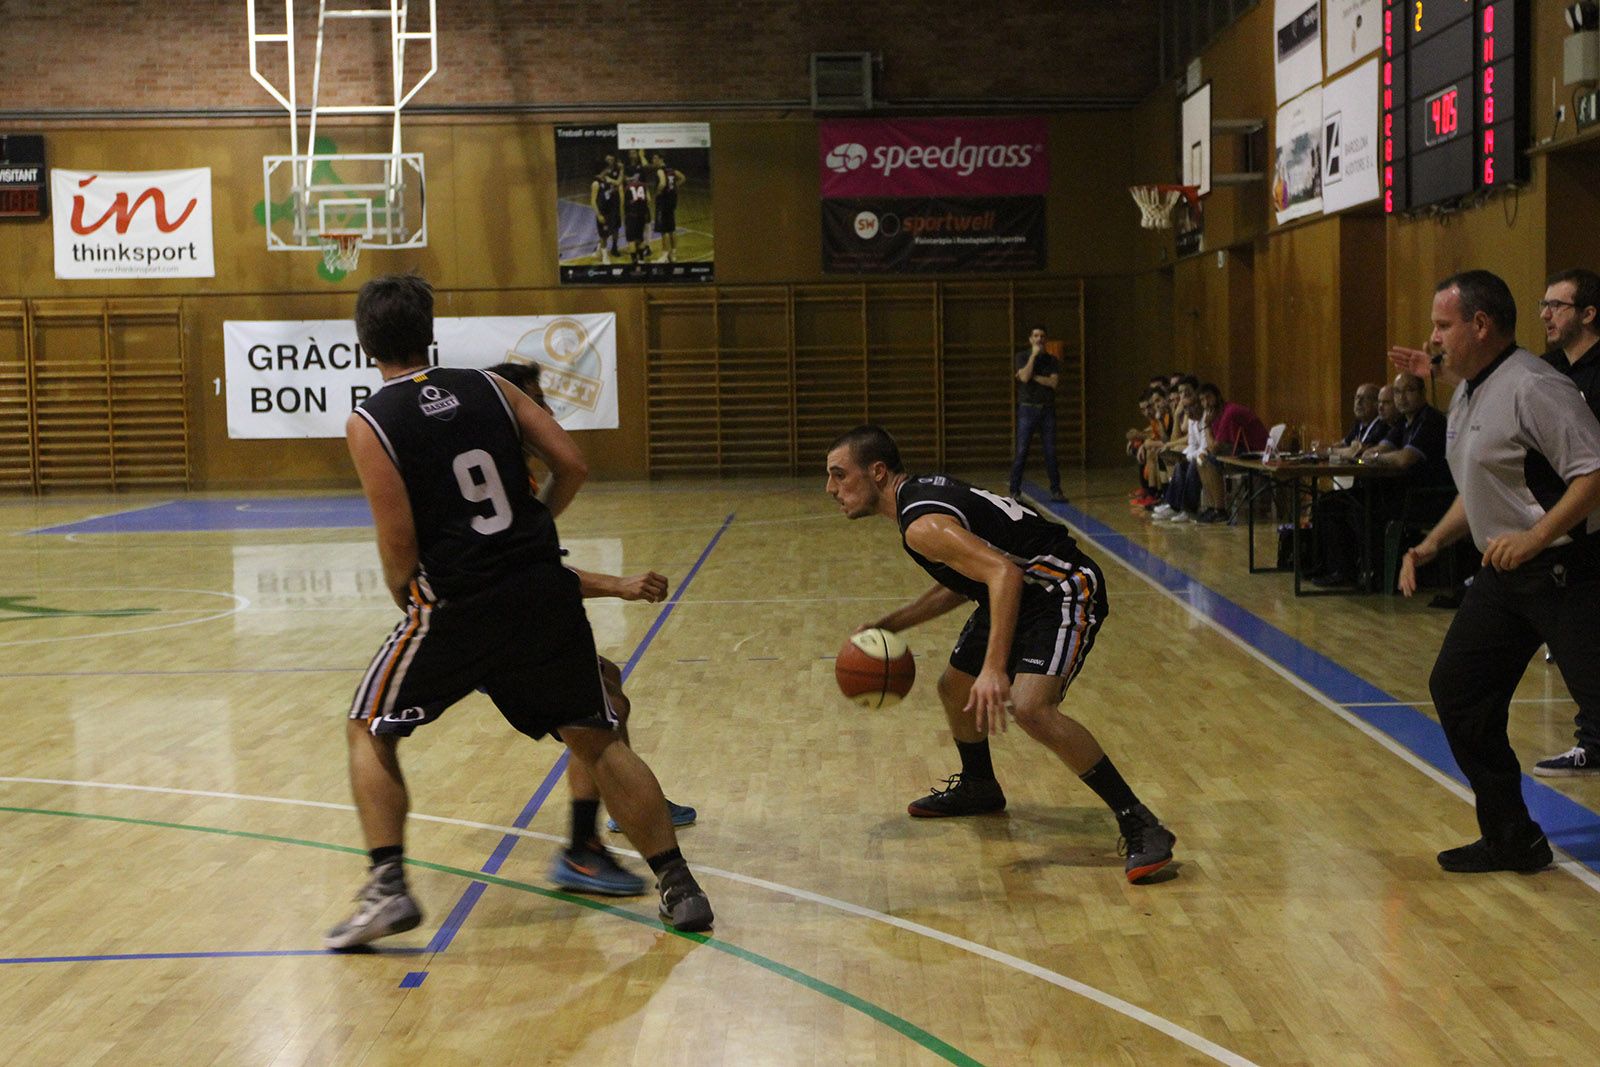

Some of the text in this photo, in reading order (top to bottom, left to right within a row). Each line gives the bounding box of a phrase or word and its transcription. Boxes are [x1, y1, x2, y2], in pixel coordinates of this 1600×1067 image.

[870, 136, 1032, 177] speedgrass
[72, 242, 198, 265] thinksport
[251, 387, 327, 413] BON
[452, 448, 513, 535] 9
